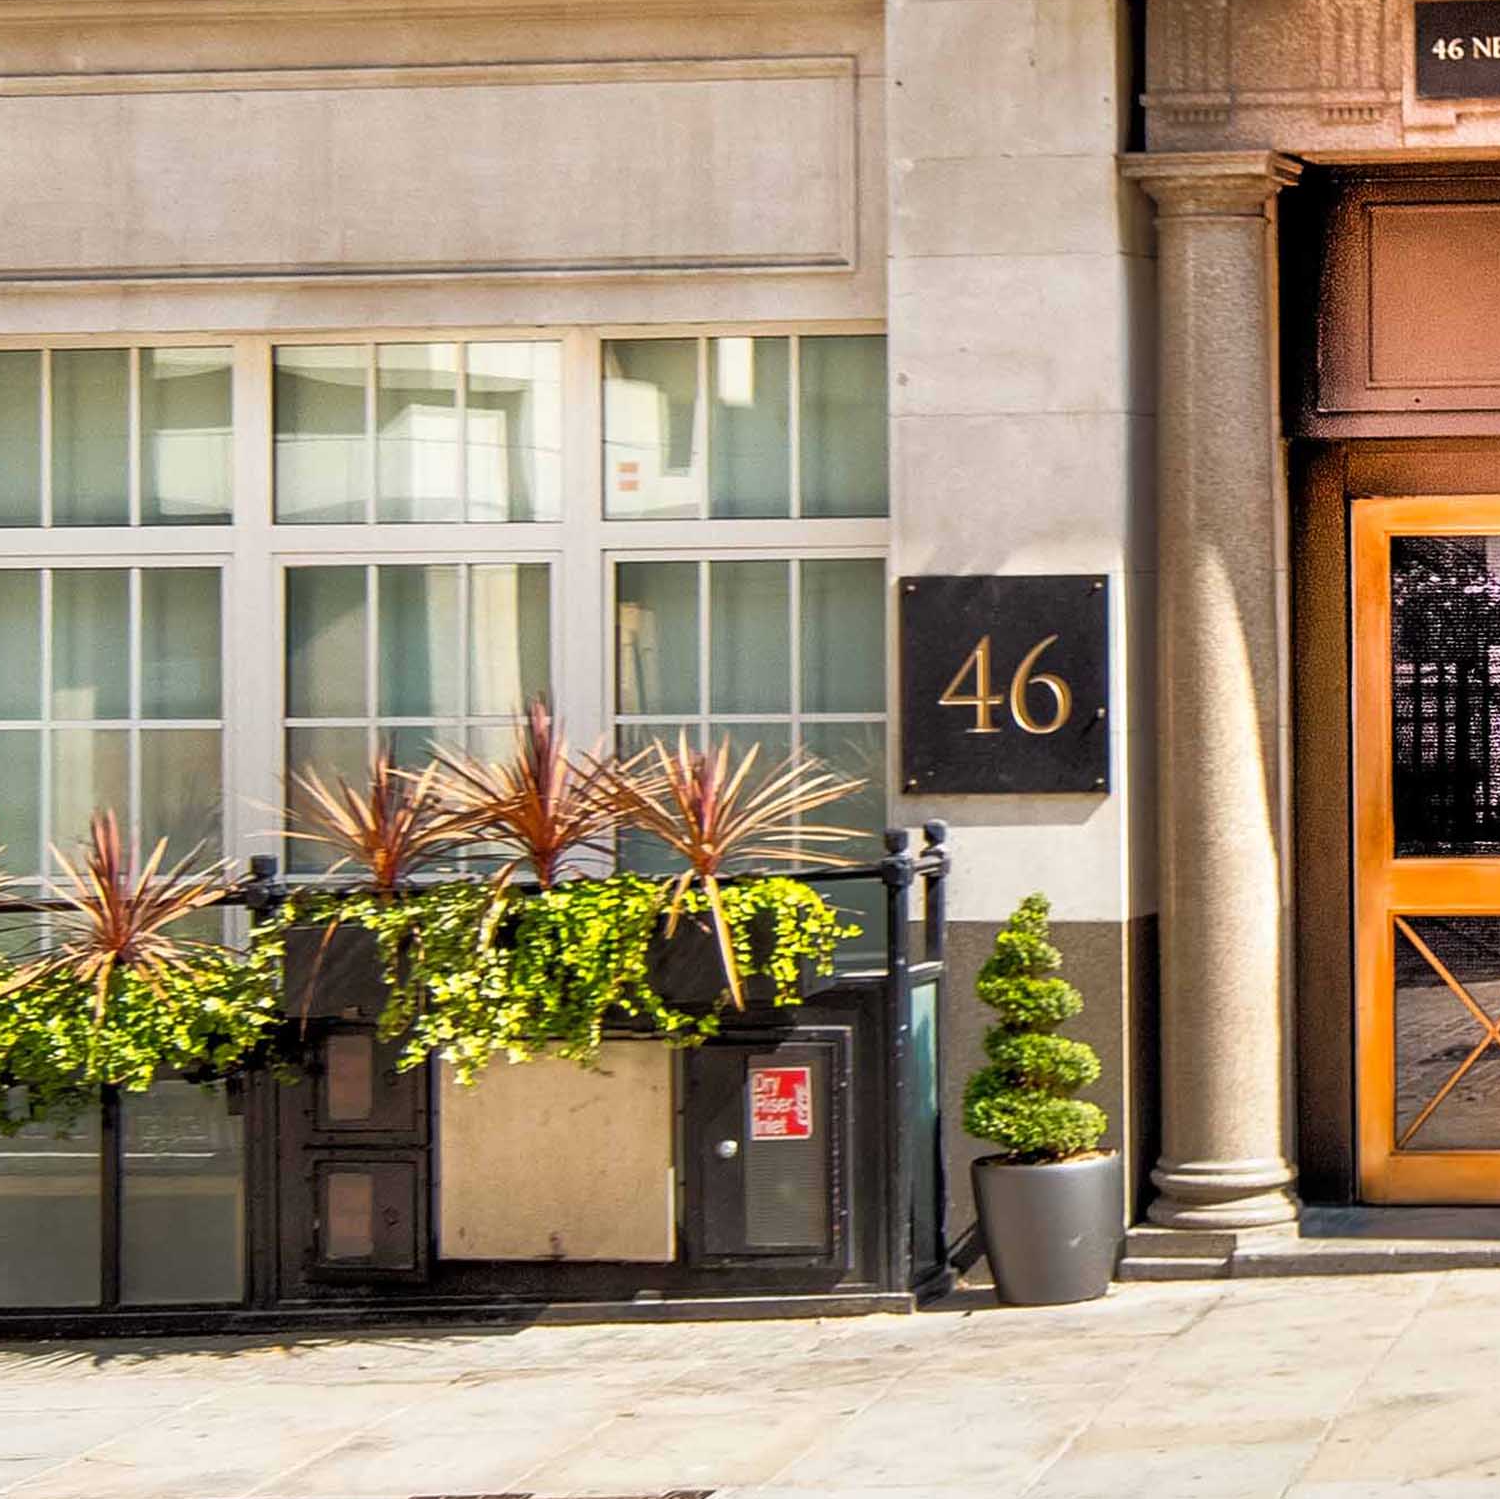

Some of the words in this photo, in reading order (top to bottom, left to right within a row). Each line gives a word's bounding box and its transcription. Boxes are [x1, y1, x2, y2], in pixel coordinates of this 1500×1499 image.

[1431, 37, 1465, 61] 46
[938, 634, 1073, 734] 46
[752, 1072, 782, 1099] Dry
